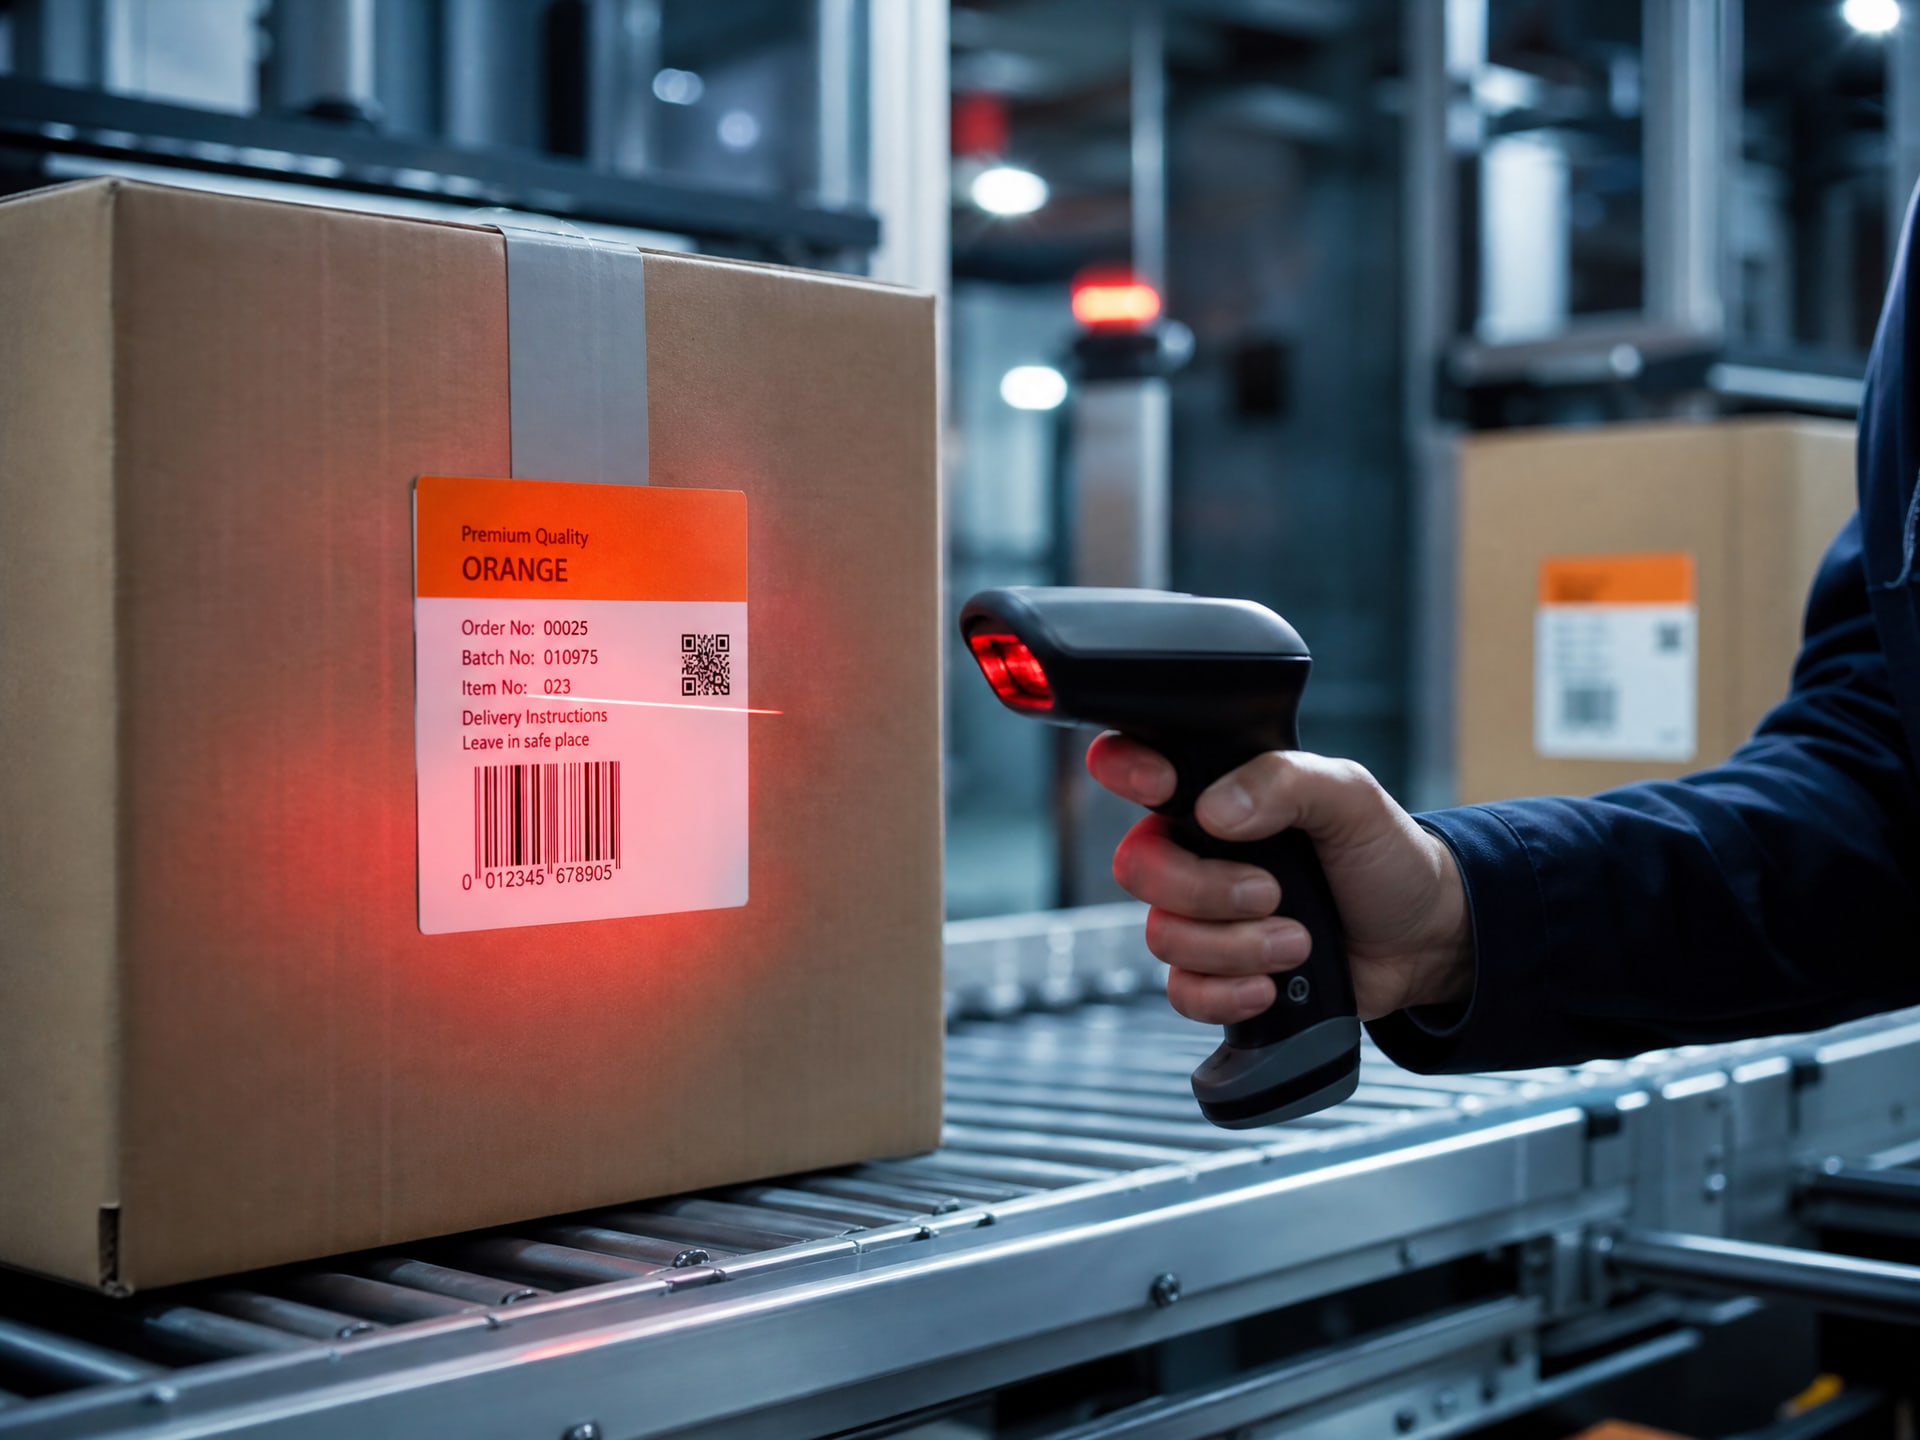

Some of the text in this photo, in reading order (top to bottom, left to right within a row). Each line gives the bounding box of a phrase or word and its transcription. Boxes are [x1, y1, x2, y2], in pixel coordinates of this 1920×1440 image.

[462, 525, 589, 549] Premium Quality
[462, 556, 568, 582] ORANGE
[462, 618, 588, 636] Order No: 00025
[462, 648, 598, 665] Batch No: 010975
[462, 678, 571, 696] Item No: 023
[462, 708, 607, 728] Delivery Instructions
[463, 732, 589, 751] Leave in safe place
[462, 864, 612, 890] 0 012345 678905
